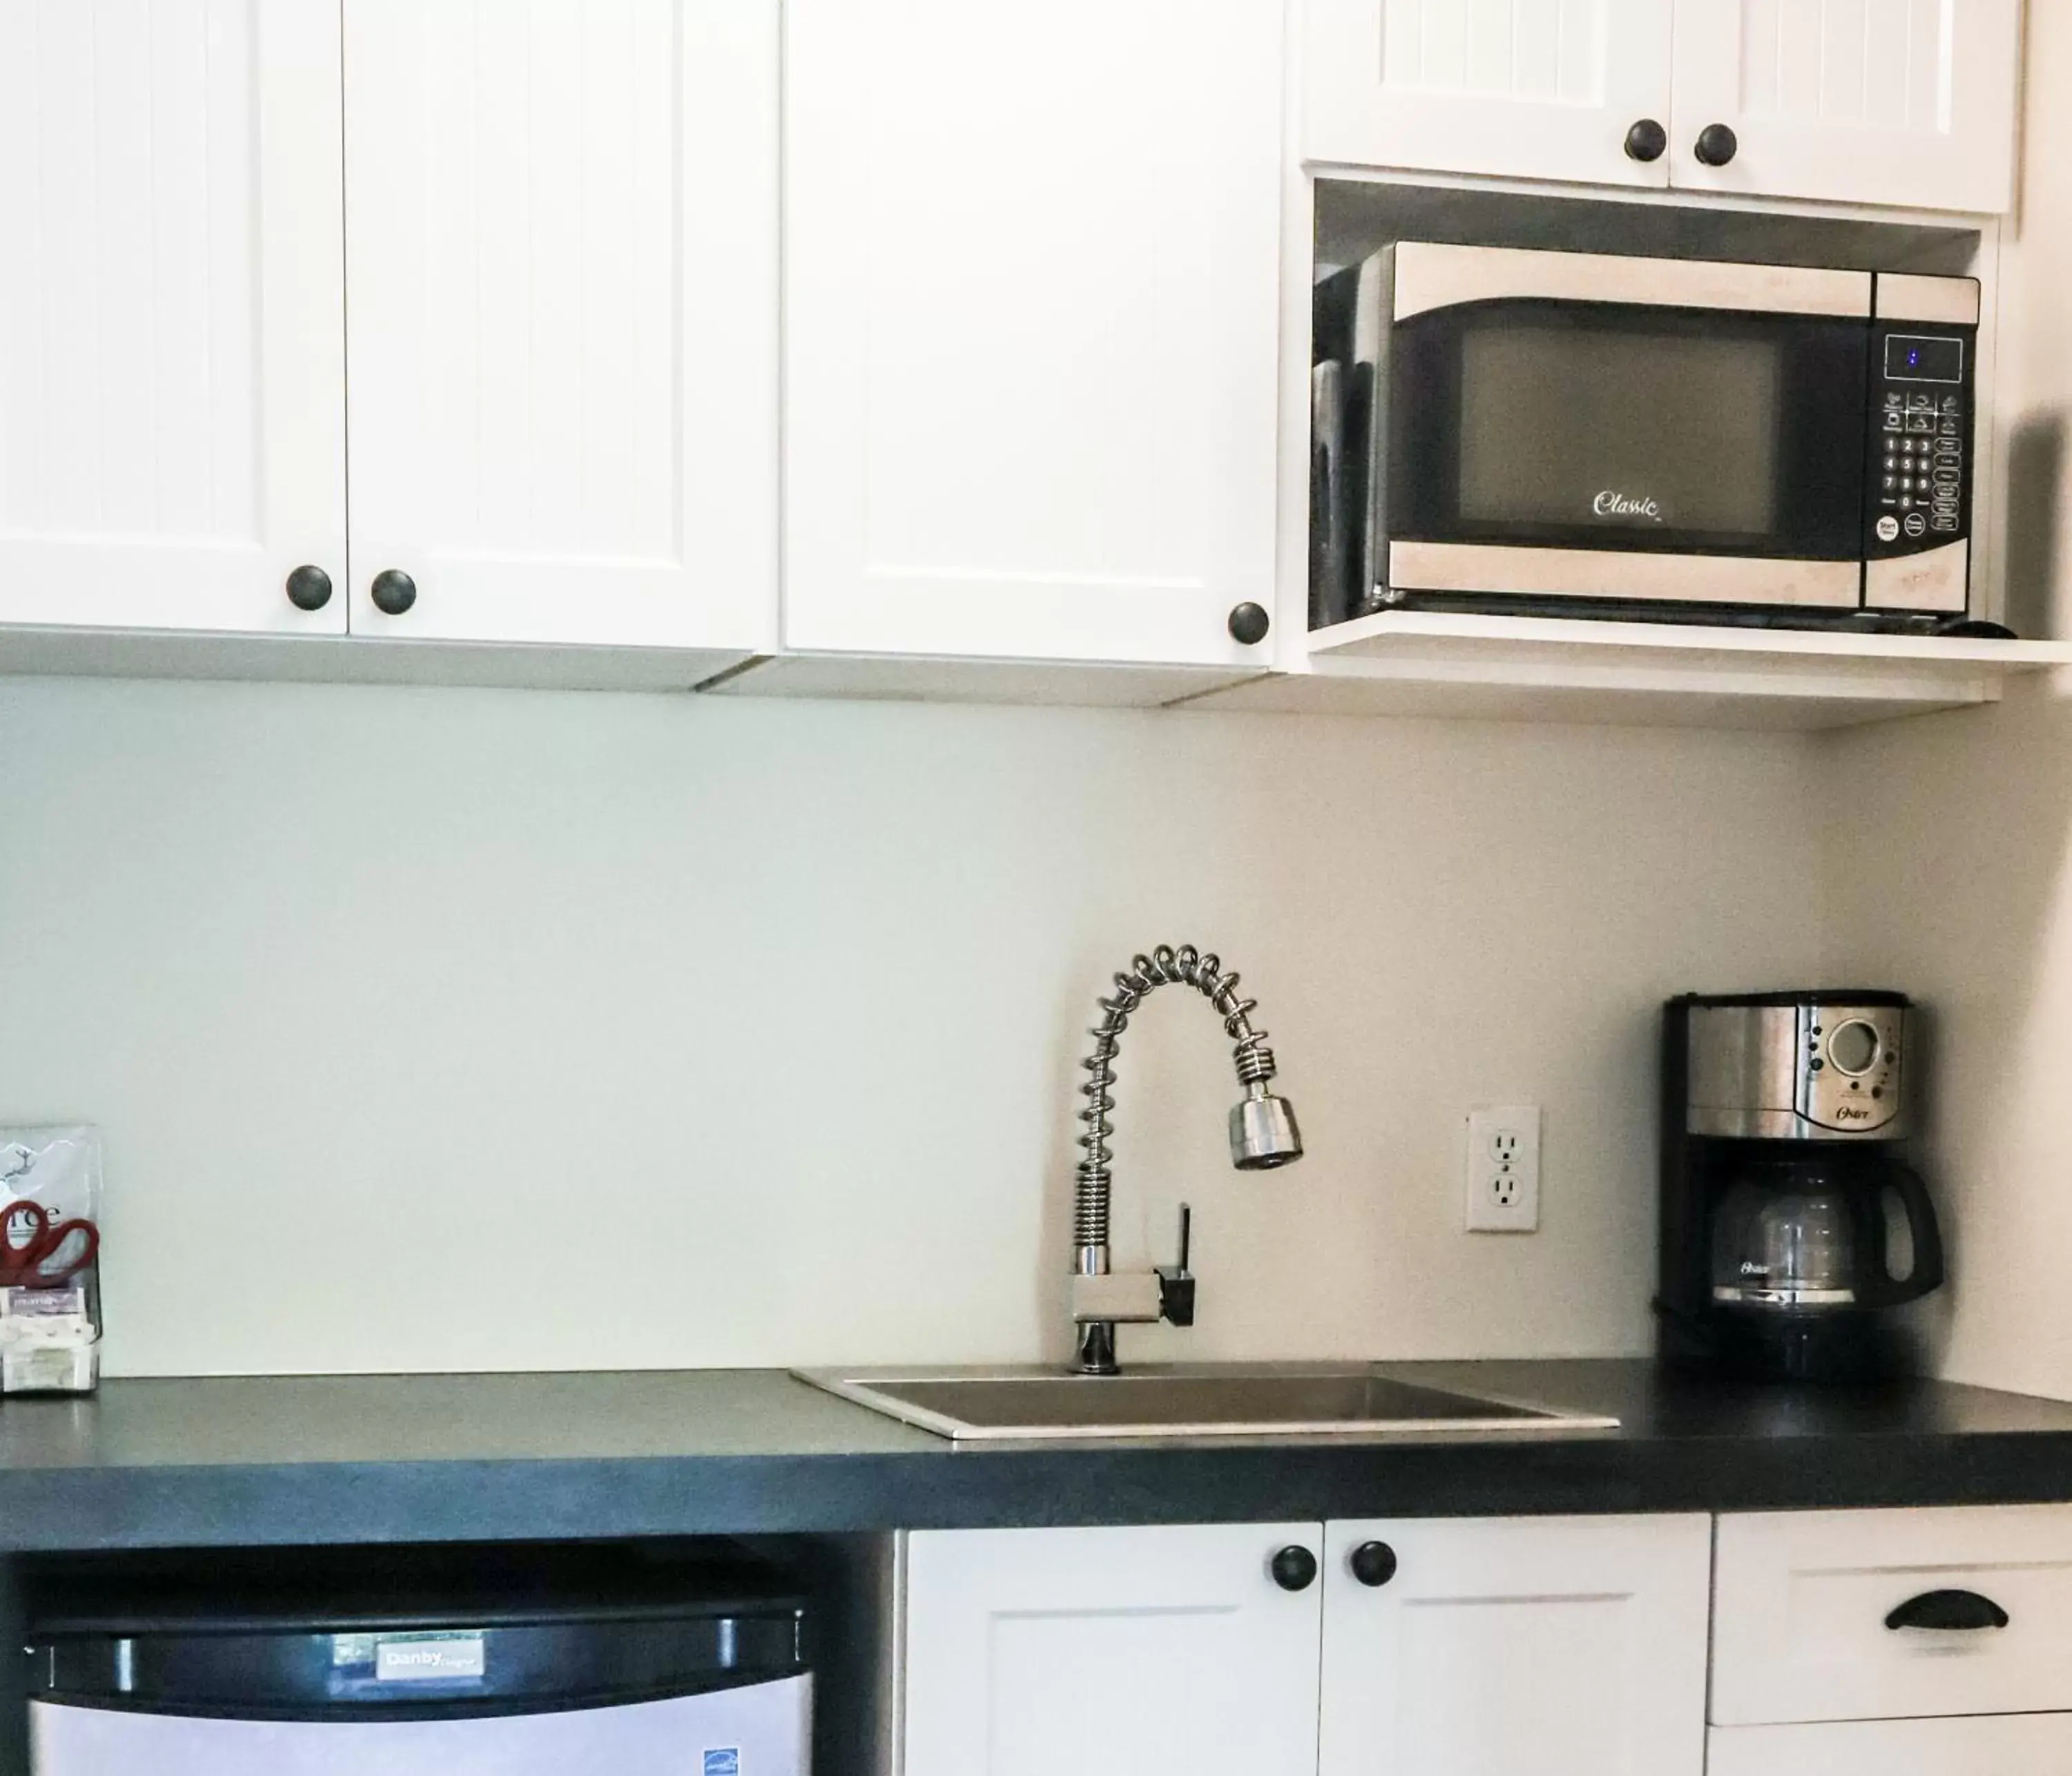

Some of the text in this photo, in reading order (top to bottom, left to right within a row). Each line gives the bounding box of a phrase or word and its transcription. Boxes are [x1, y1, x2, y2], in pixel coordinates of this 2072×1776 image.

[1905, 440, 1912, 450] 2
[1922, 441, 1928, 451] 3
[1888, 458, 1893, 468] 4
[1903, 459, 1910, 470] 5
[1886, 476, 1892, 487] 7
[1921, 479, 1927, 489] 9
[1593, 490, 1660, 517] Classic
[1903, 496, 1909, 506] 0
[385, 1651, 441, 1667] Danby
